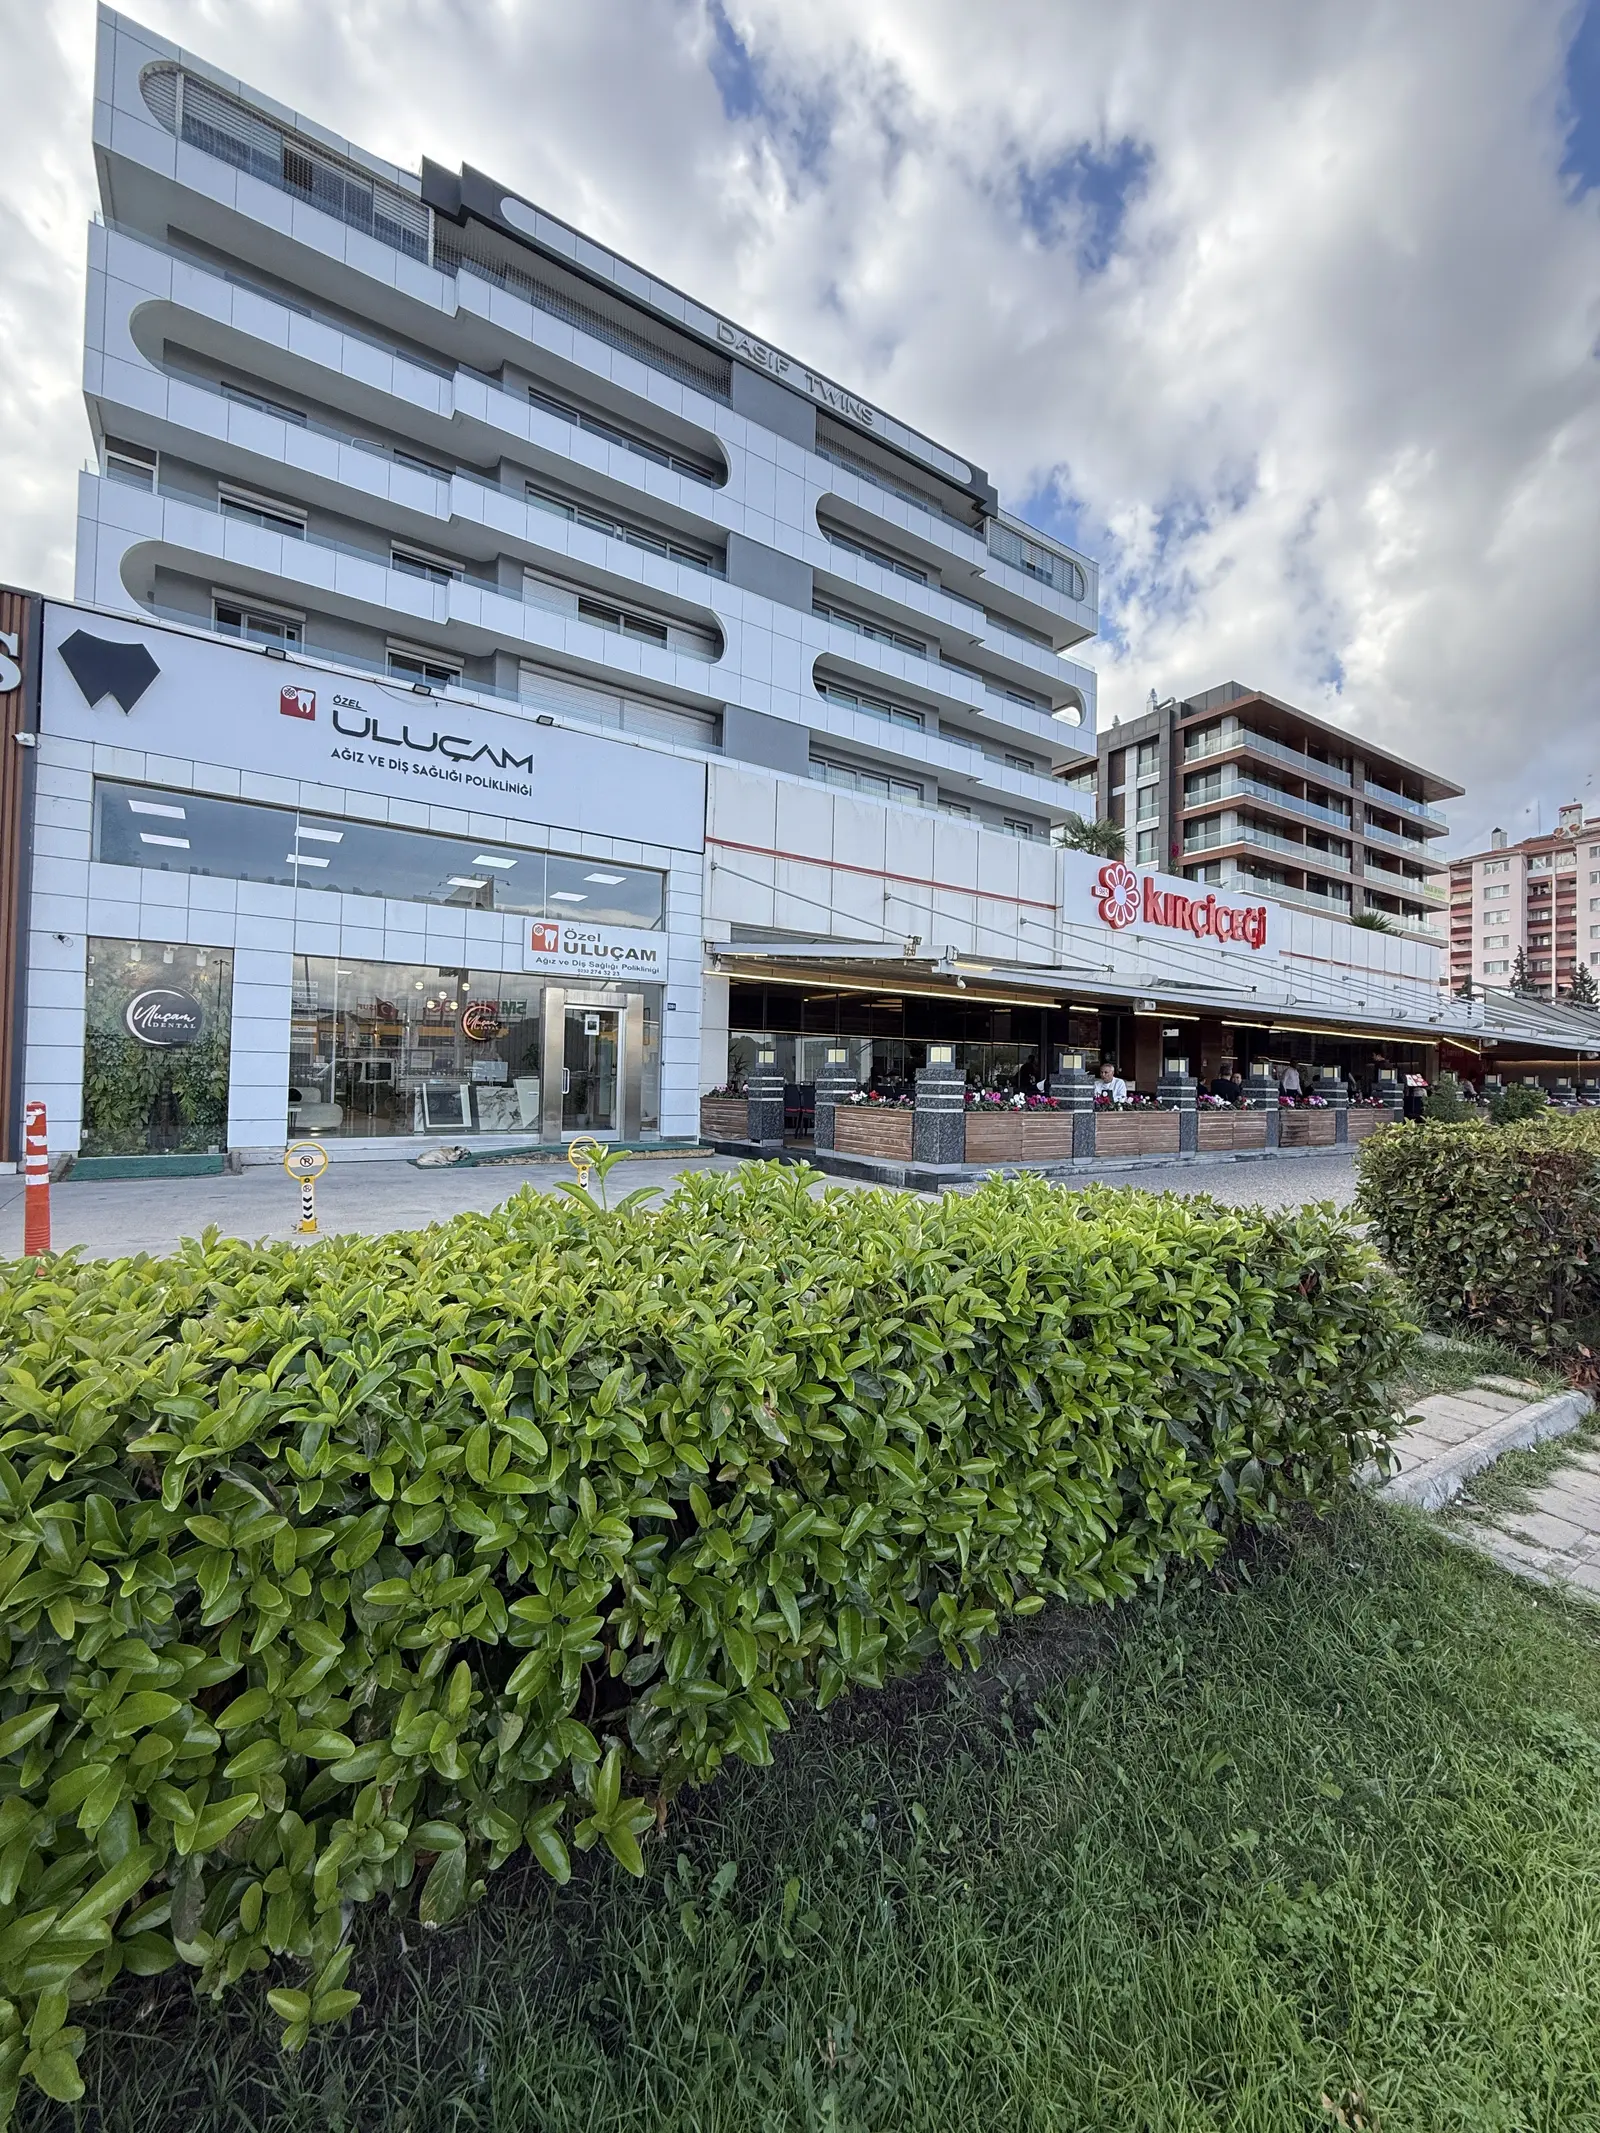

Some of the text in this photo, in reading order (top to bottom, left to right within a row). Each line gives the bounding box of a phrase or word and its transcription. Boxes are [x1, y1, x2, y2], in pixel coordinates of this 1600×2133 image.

[804, 371, 875, 426] TWINS
[332, 694, 362, 709] ÖZEL
[332, 710, 533, 774] ULUÇAM
[331, 747, 533, 797] AĞIZ VE DİŞ SAĞLIĞI POLİKLİNİĞİ
[564, 928, 601, 942] Özel
[563, 942, 657, 961] ULUÇAM
[536, 956, 556, 966] Ağız
[572, 959, 586, 968] Diş
[588, 961, 619, 970] Sağlığı
